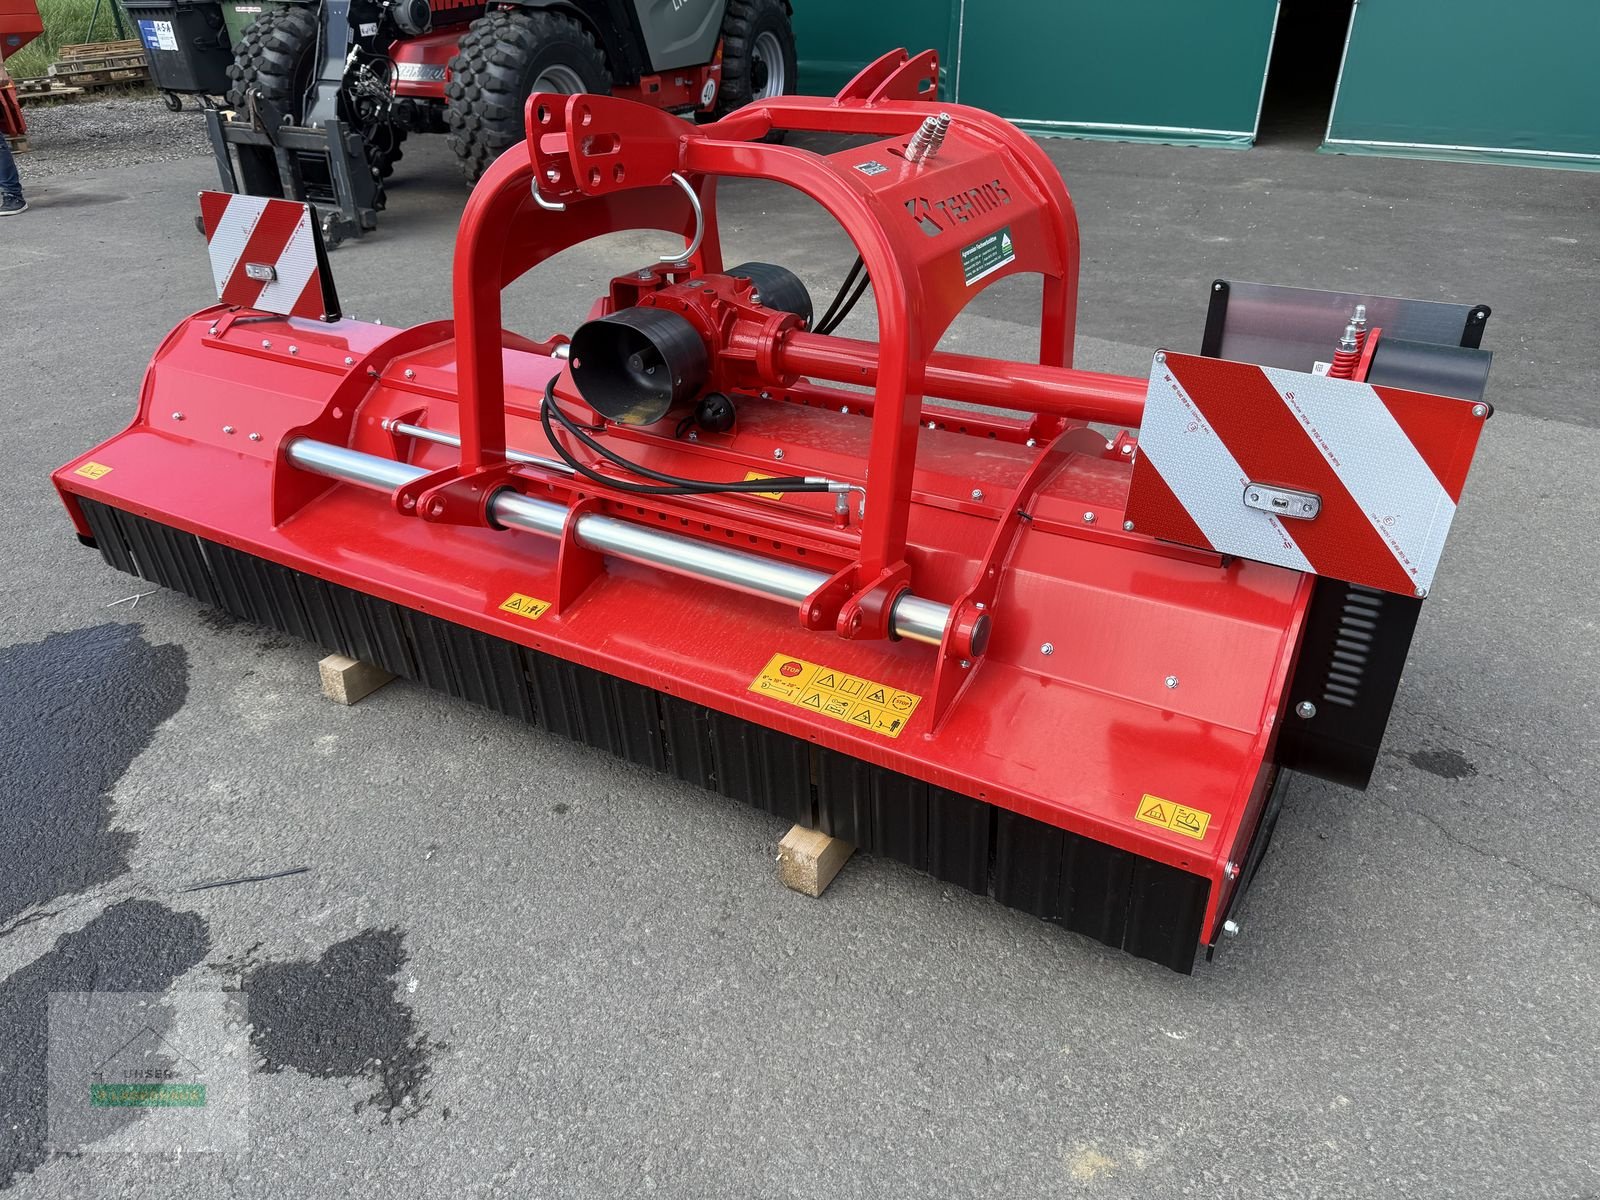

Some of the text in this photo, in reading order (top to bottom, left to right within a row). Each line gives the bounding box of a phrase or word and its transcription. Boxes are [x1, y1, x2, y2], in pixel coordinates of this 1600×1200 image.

[704, 83, 714, 101] 40
[935, 179, 1012, 226] TEHNOS
[783, 665, 800, 674] STOP
